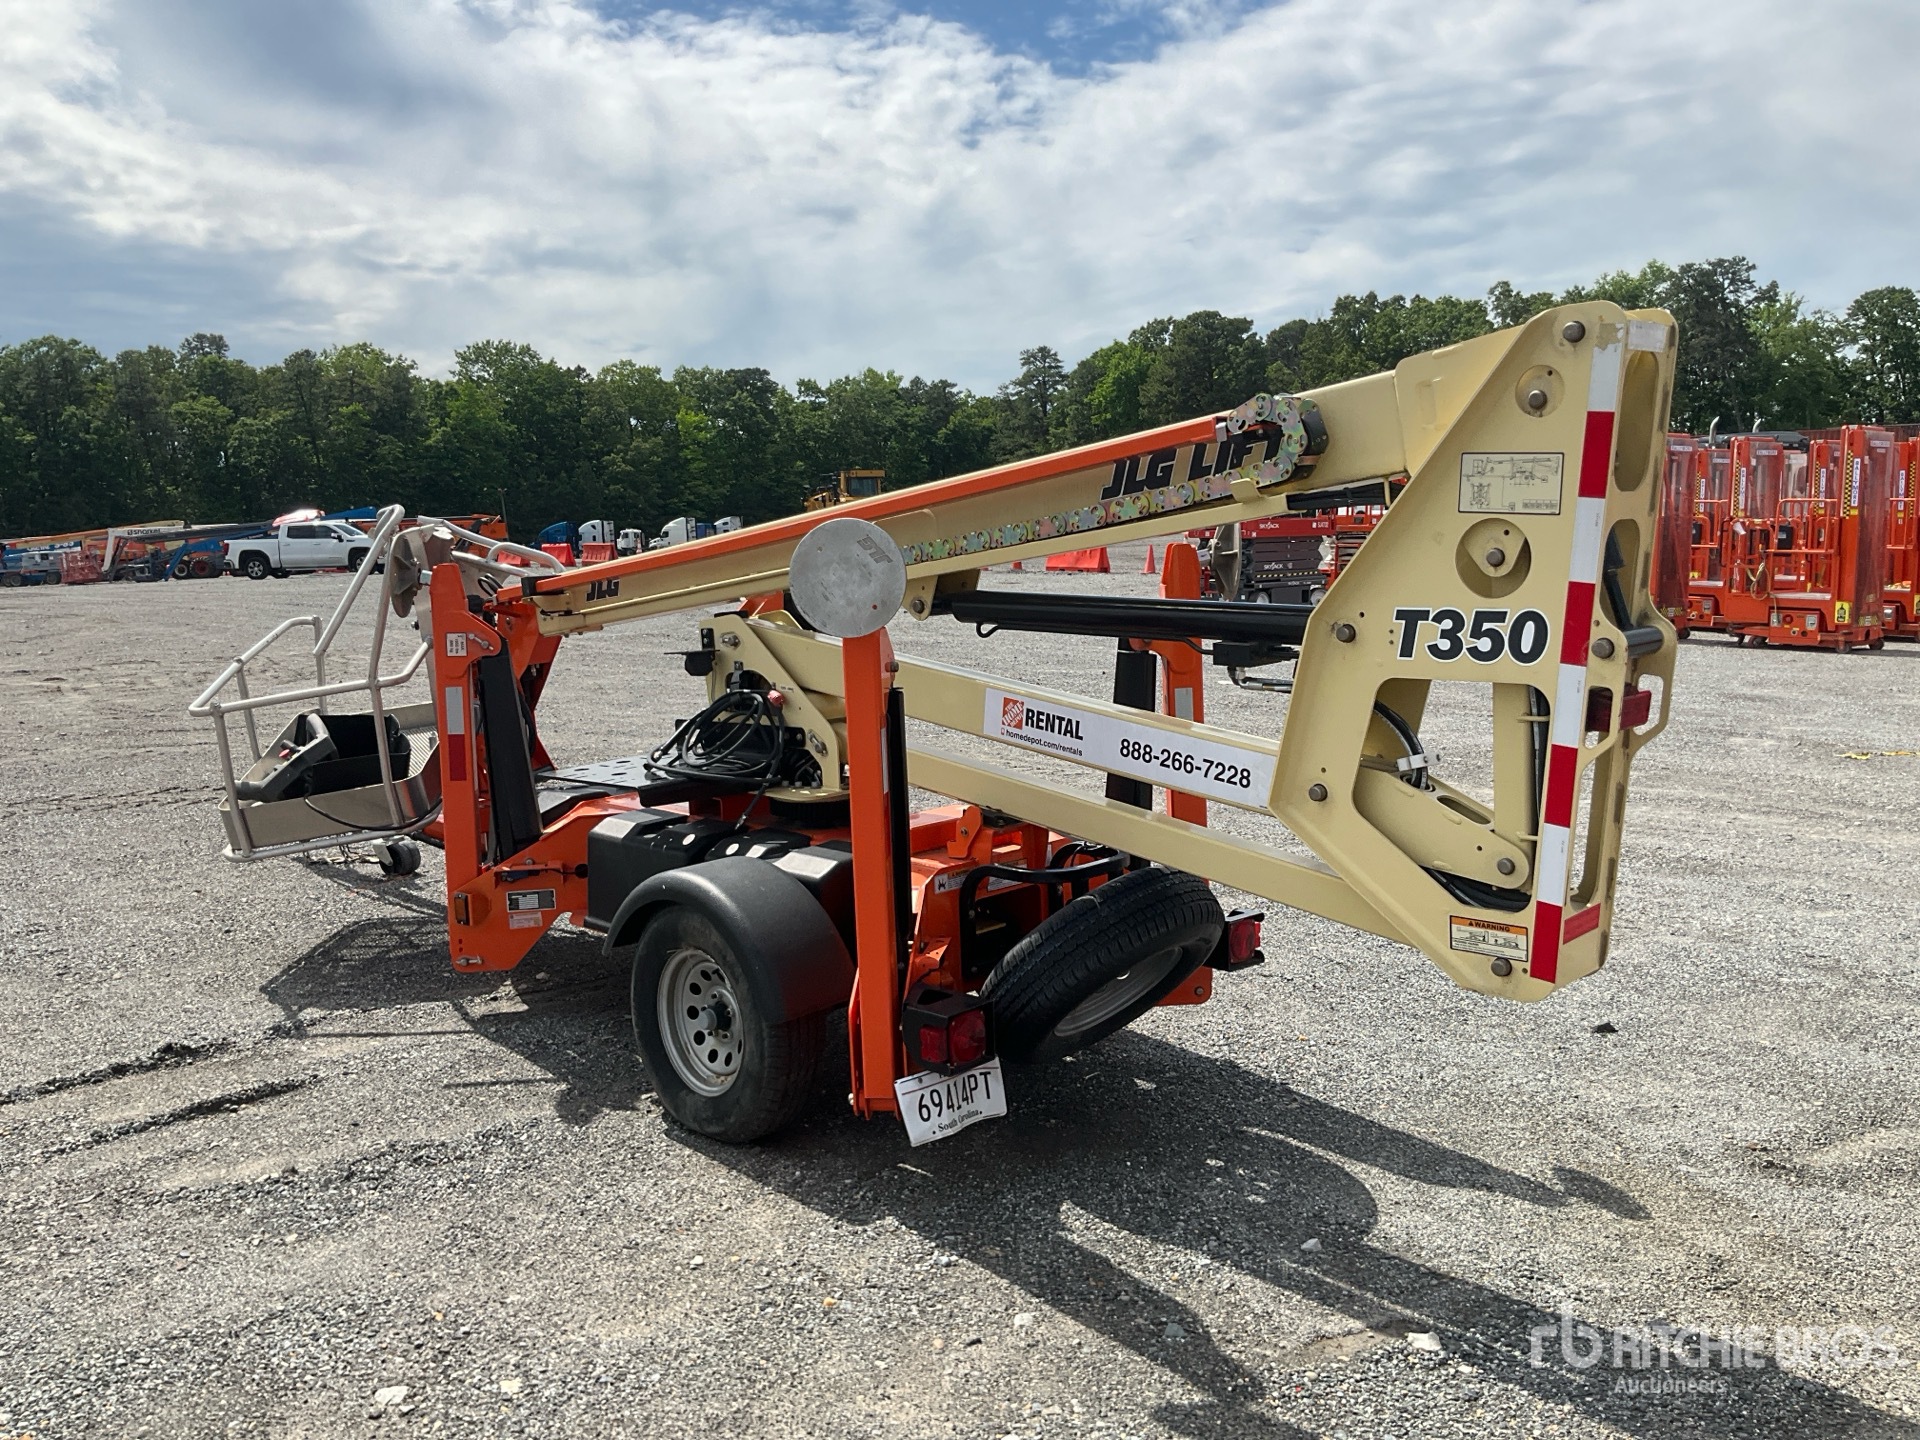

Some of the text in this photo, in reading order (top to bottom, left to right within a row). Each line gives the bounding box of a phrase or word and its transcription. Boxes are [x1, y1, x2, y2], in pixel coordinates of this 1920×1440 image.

[1101, 447, 1178, 500] JLG
[1852, 459, 1860, 505] BALLYMORE
[1259, 521, 1279, 529] SKYJACK
[1263, 562, 1283, 570] SKYJACK
[586, 577, 620, 601] JLG
[1393, 607, 1551, 666] T350
[1002, 700, 1024, 726] HOME
[1025, 707, 1084, 741] RENTAL
[1006, 729, 1083, 757] homedepot.com/rentals
[1120, 738, 1251, 789] 888-266-7228
[1475, 921, 1510, 932] WARNING
[938, 1108, 979, 1132] South Carolina
